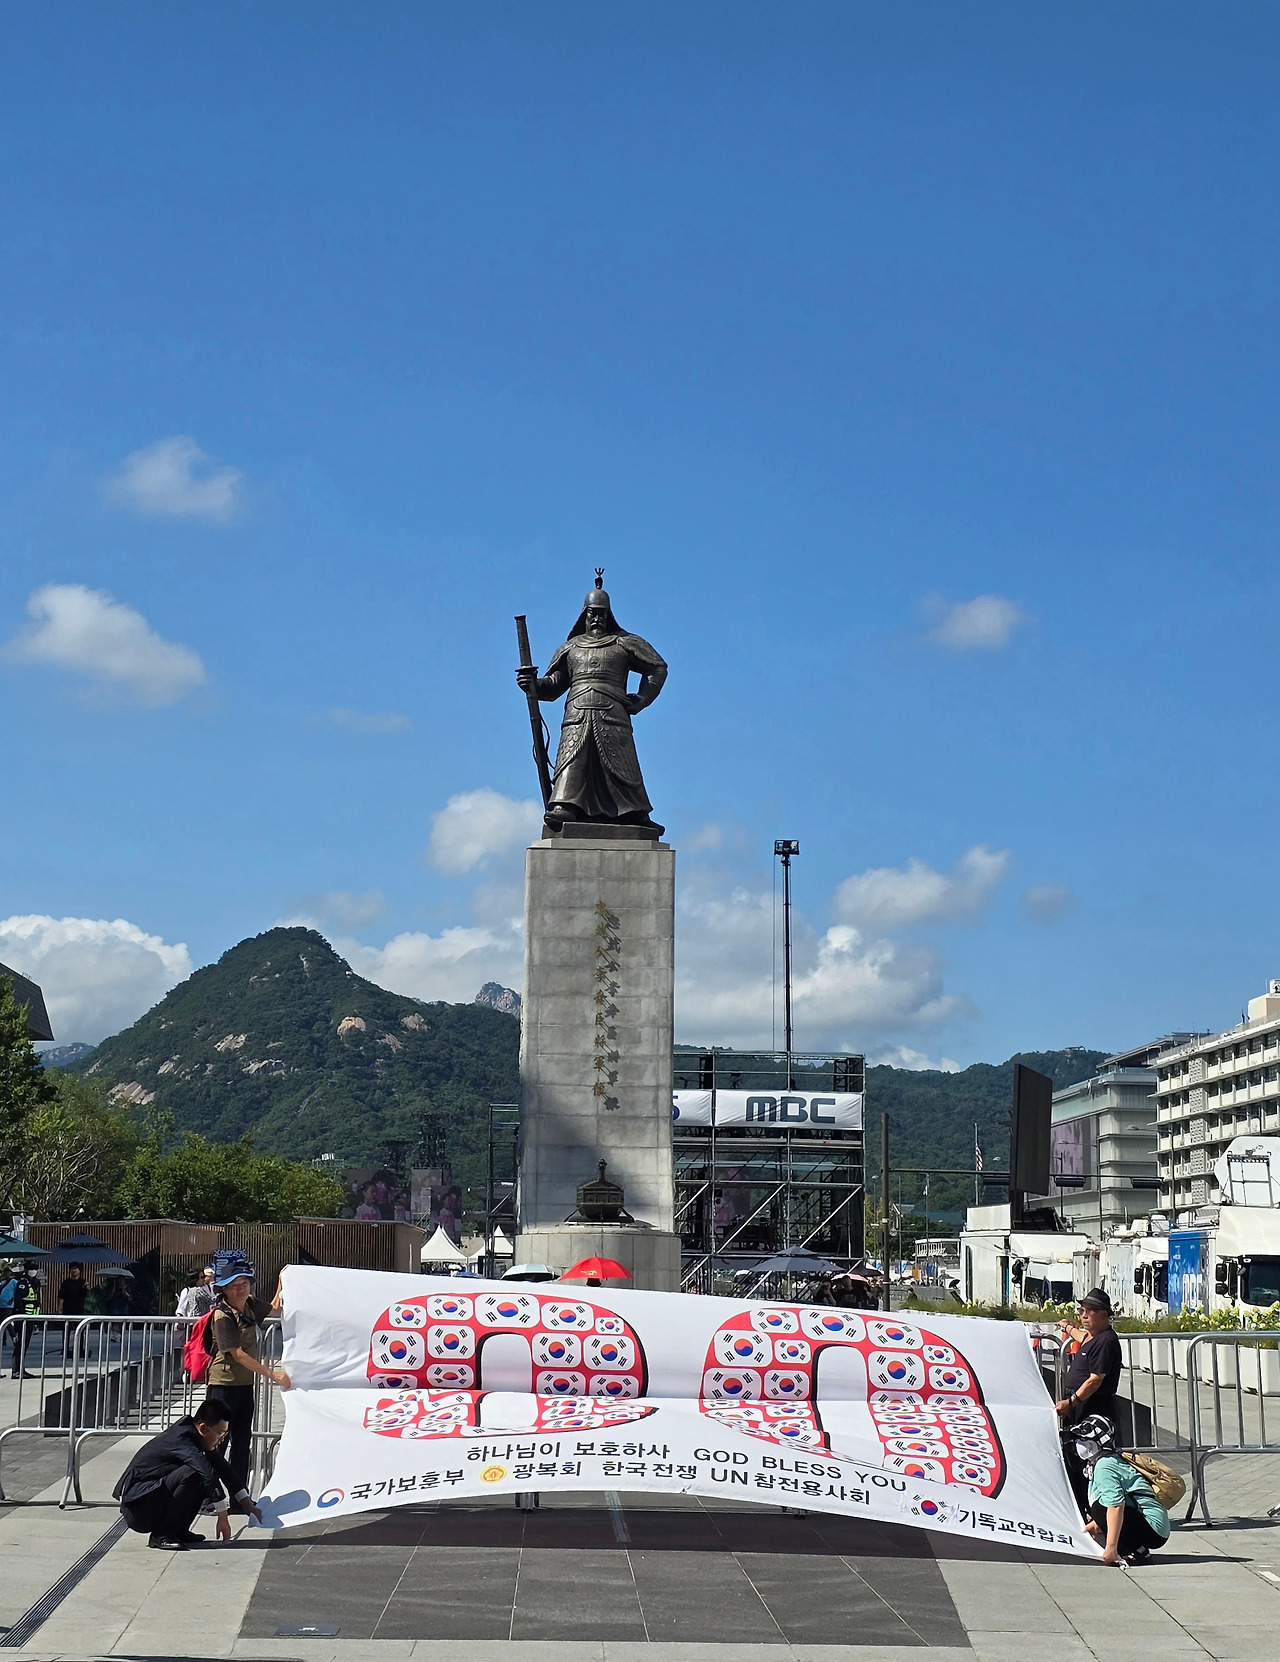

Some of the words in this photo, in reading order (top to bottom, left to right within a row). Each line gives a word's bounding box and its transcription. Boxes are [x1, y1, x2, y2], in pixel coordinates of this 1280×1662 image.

[745, 1096, 836, 1124] MBC
[466, 1442, 562, 1462] 하나님이
[573, 1442, 671, 1460] 보호하사
[693, 1448, 749, 1465] GOD
[762, 1455, 842, 1480] BLESS
[854, 1470, 907, 1492] YOU
[350, 1469, 465, 1500] 국가보훈부
[512, 1461, 582, 1480] 광복회
[602, 1461, 697, 1480] 한국전쟁
[959, 1509, 1075, 1548] 기독교연합회
